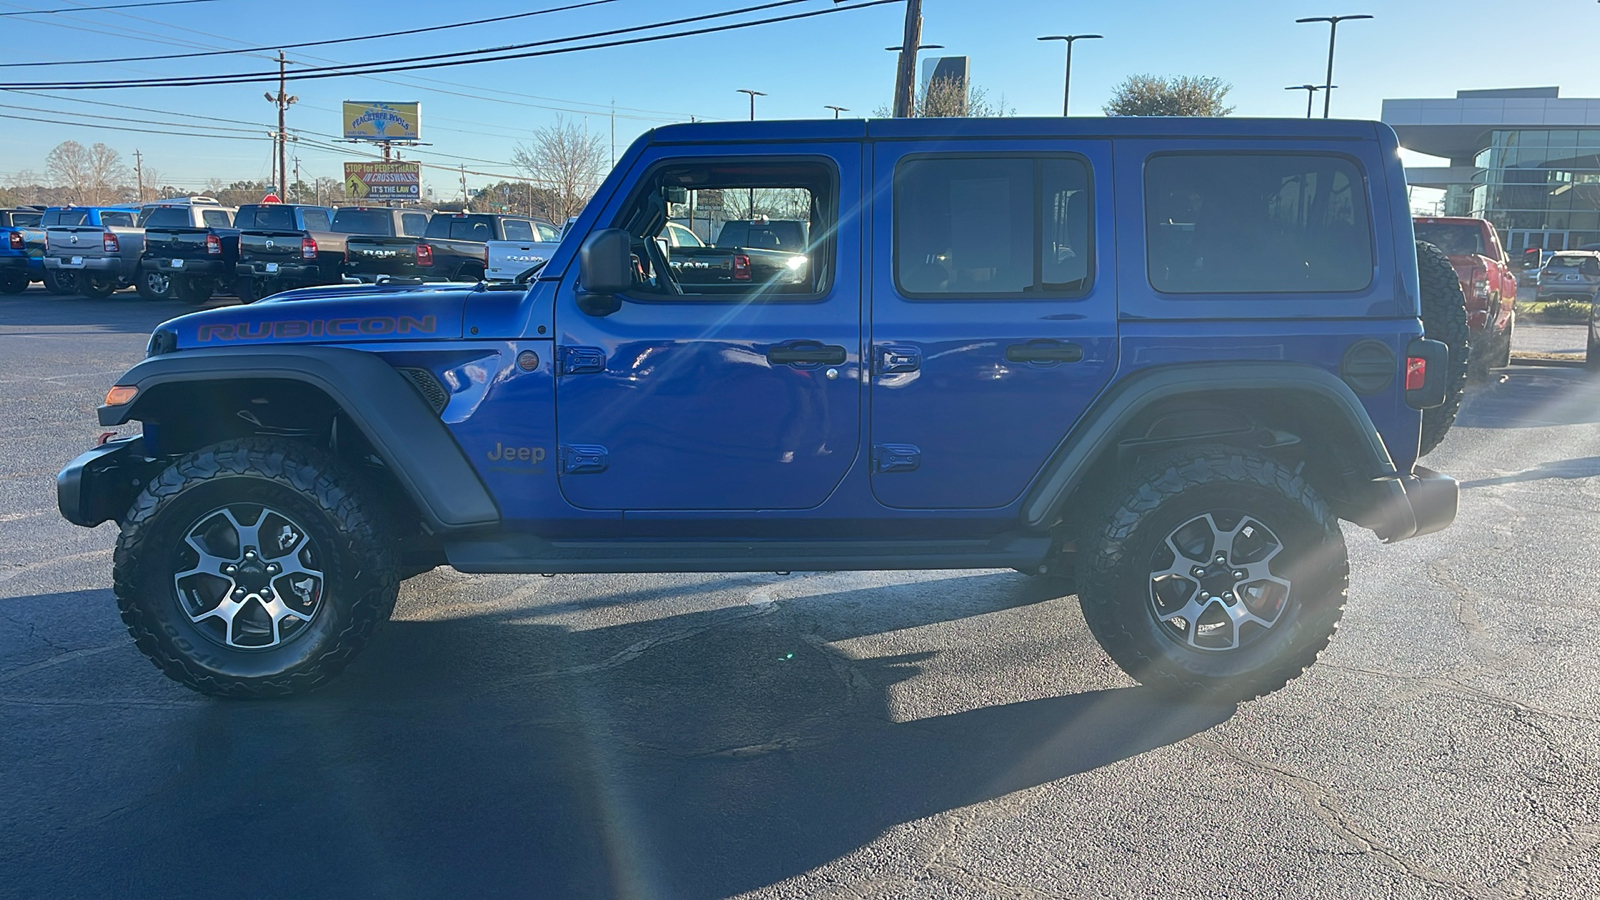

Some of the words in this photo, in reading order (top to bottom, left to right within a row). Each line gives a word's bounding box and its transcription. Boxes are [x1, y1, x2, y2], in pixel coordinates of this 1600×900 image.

[351, 112, 388, 129] PEACHTREE
[389, 113, 410, 131] POOLS
[345, 163, 362, 173] STOP
[363, 163, 373, 173] for
[374, 164, 418, 173] PEDESTRIANS
[363, 173, 372, 182] IN
[372, 173, 419, 182] CROSSWALKS
[669, 261, 709, 269] RAM
[197, 315, 436, 342] RUBICON
[487, 442, 546, 465] Jeep
